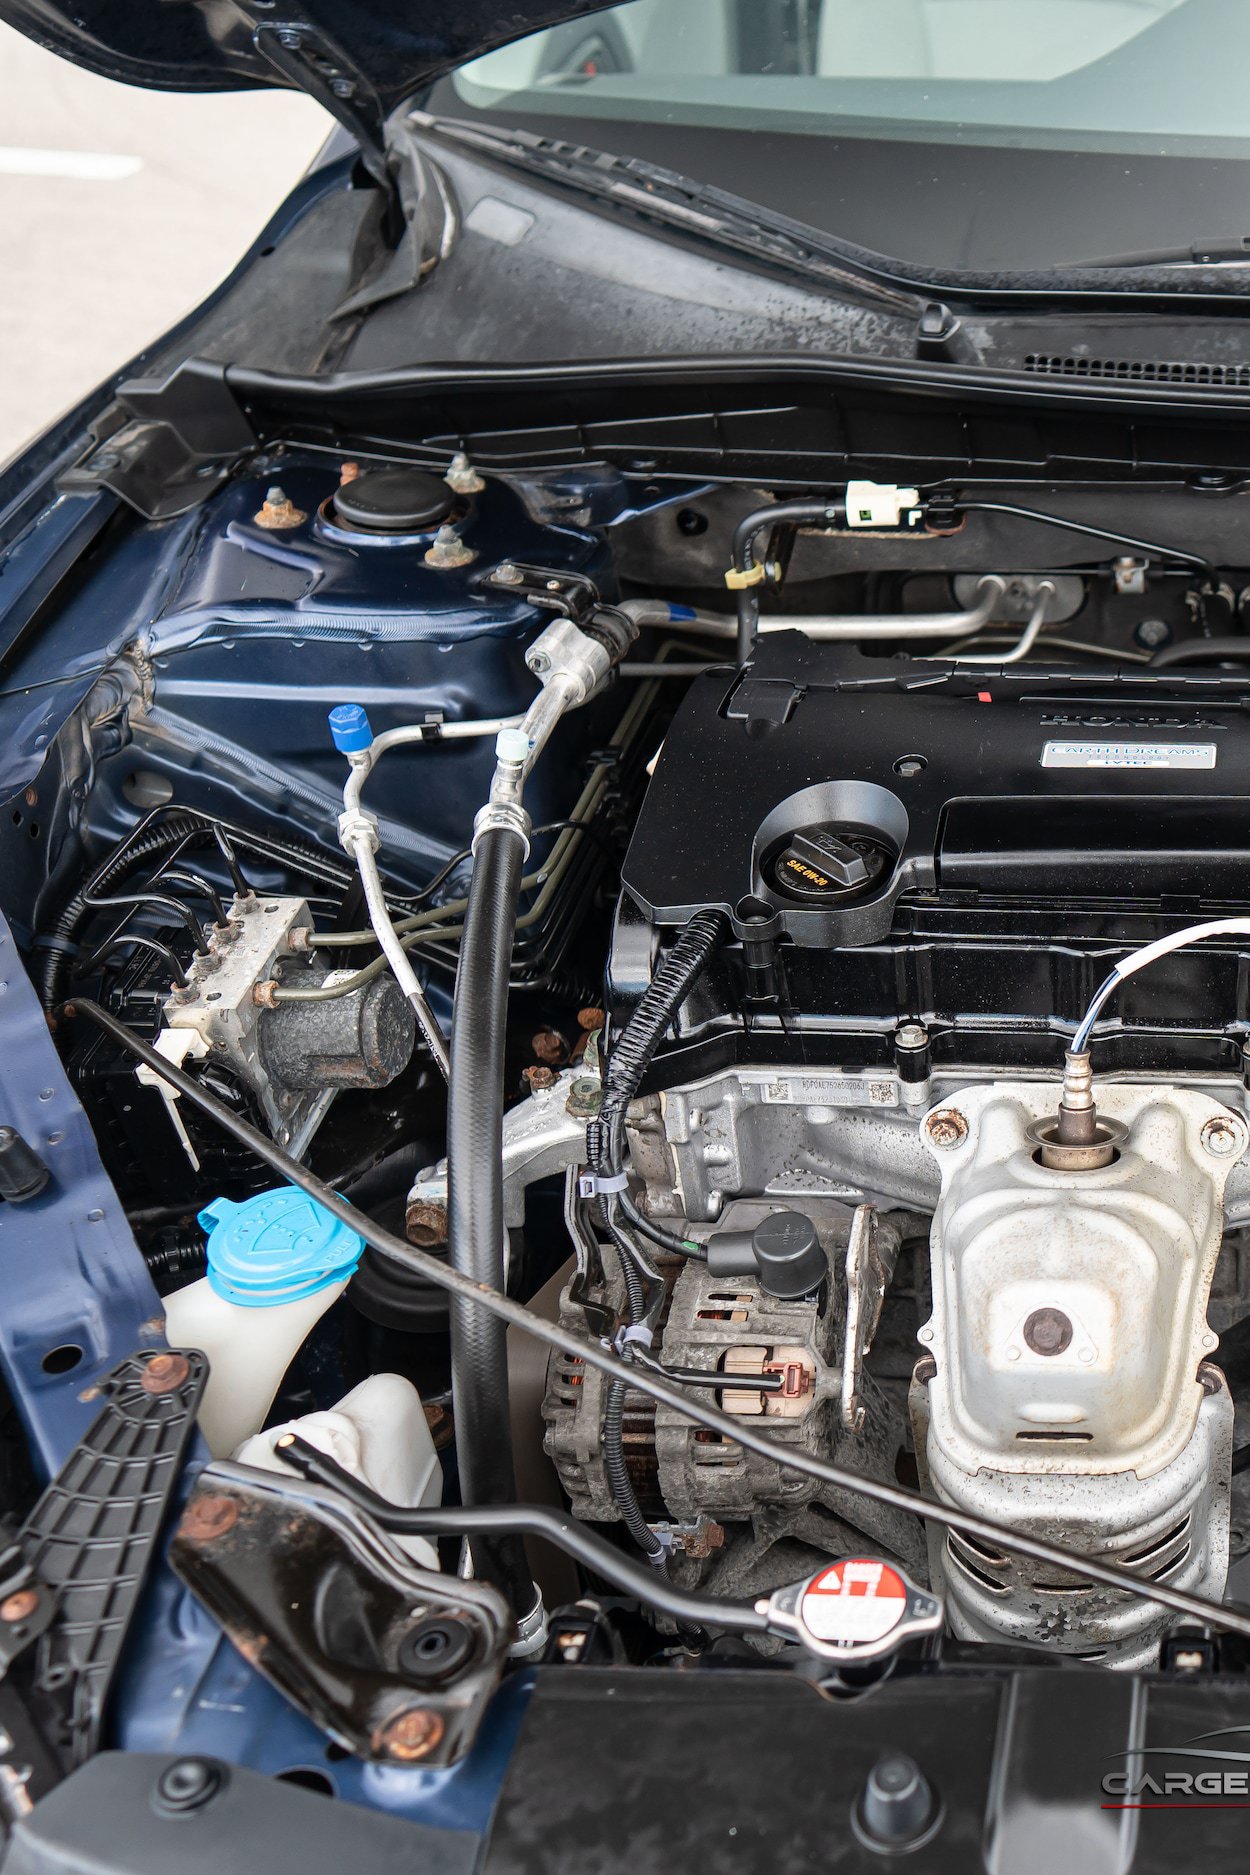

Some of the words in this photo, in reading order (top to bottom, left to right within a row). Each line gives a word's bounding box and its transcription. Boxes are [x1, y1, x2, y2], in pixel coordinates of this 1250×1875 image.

[1040, 714, 1228, 729] HONDA
[786, 859, 808, 873] SAE
[802, 869, 829, 887] 0W-20
[325, 1240, 353, 1263] PULL
